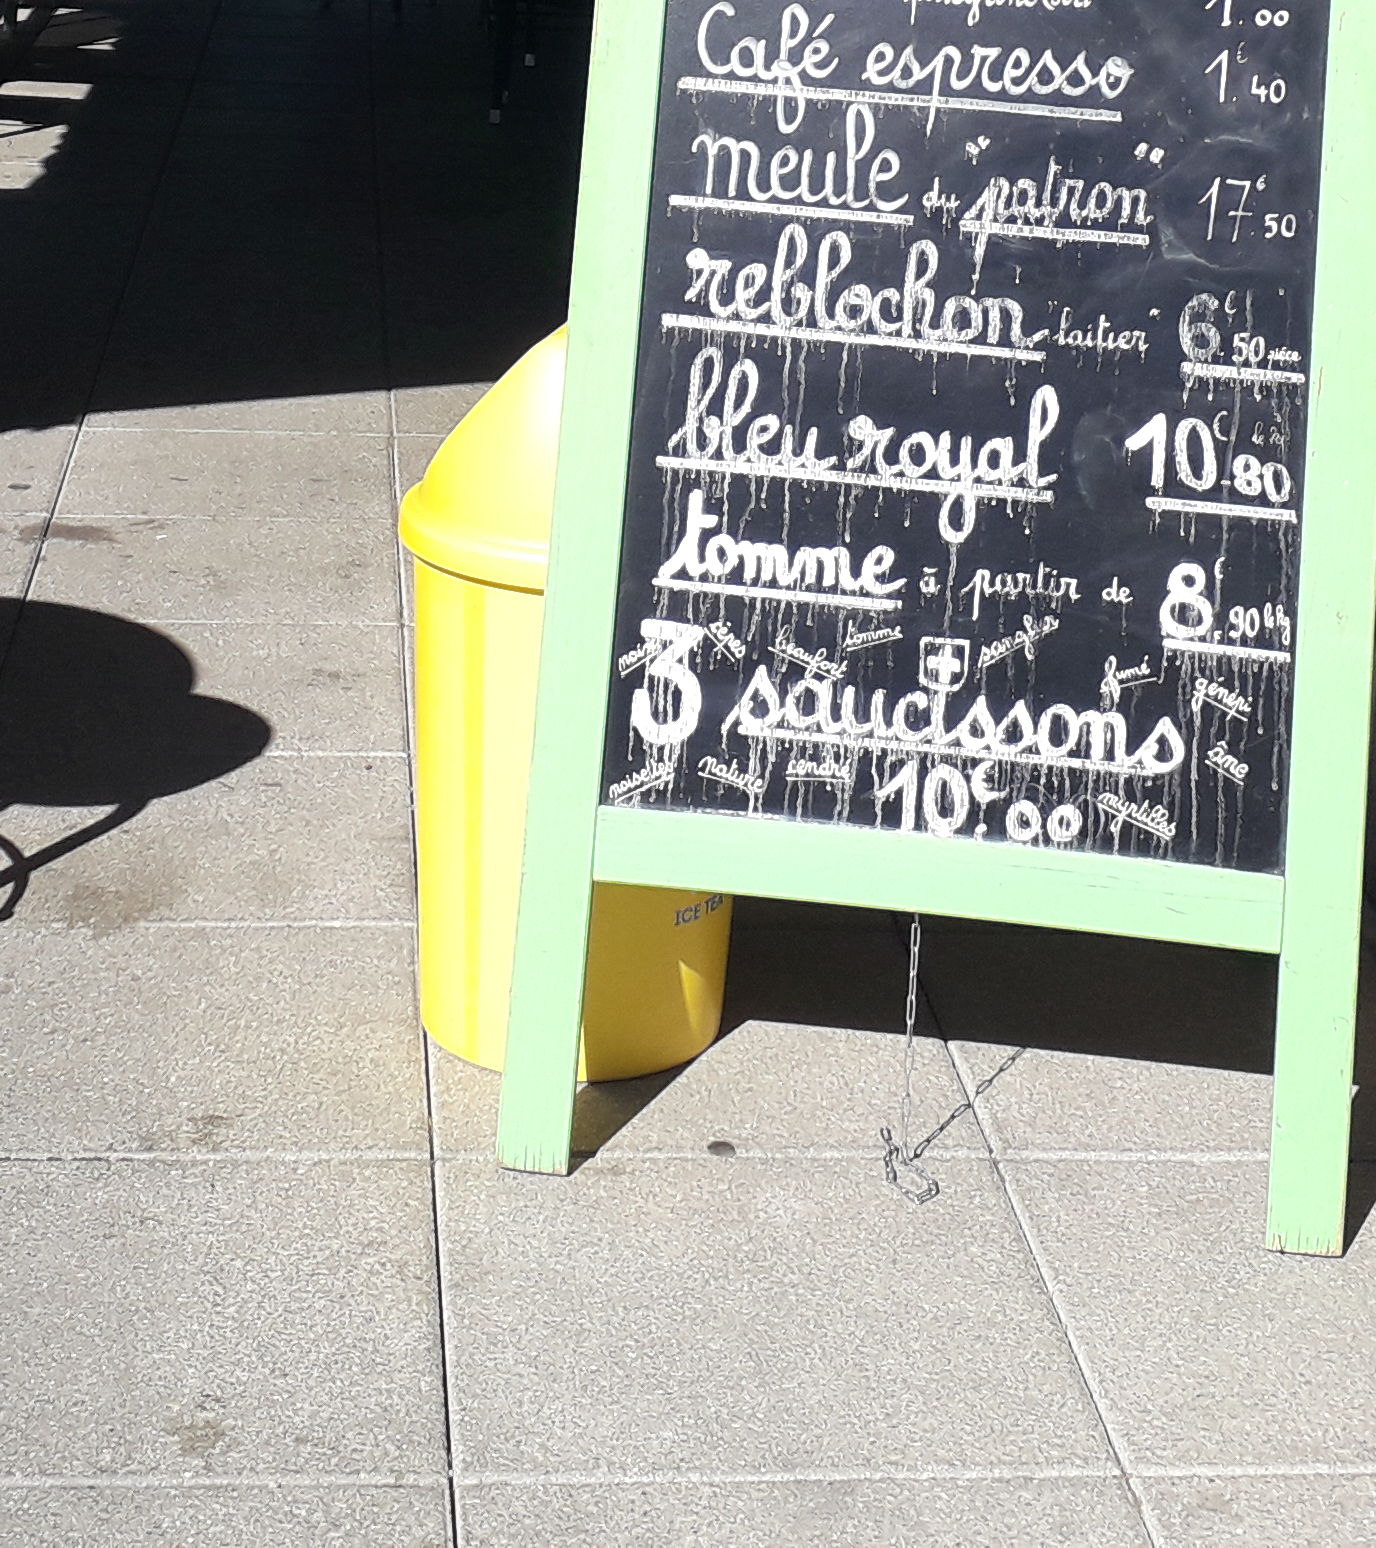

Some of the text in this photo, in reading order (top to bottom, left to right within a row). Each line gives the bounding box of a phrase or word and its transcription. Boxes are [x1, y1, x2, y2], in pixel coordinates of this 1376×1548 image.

[697, 3, 838, 132] Café
[862, 36, 1136, 138] espresso
[691, 104, 910, 214] meule
[684, 223, 1050, 350] reblochon
[668, 346, 842, 466] bleu
[846, 384, 1060, 543] royal
[657, 488, 906, 596] tomme
[960, 561, 1081, 621] partir
[1101, 576, 1134, 603] de
[774, 624, 848, 678] beaufort
[843, 619, 903, 648] tomme
[1099, 655, 1151, 705] fumé
[630, 618, 1185, 776] 3 saucissons
[674, 893, 724, 925] ICE TEA
